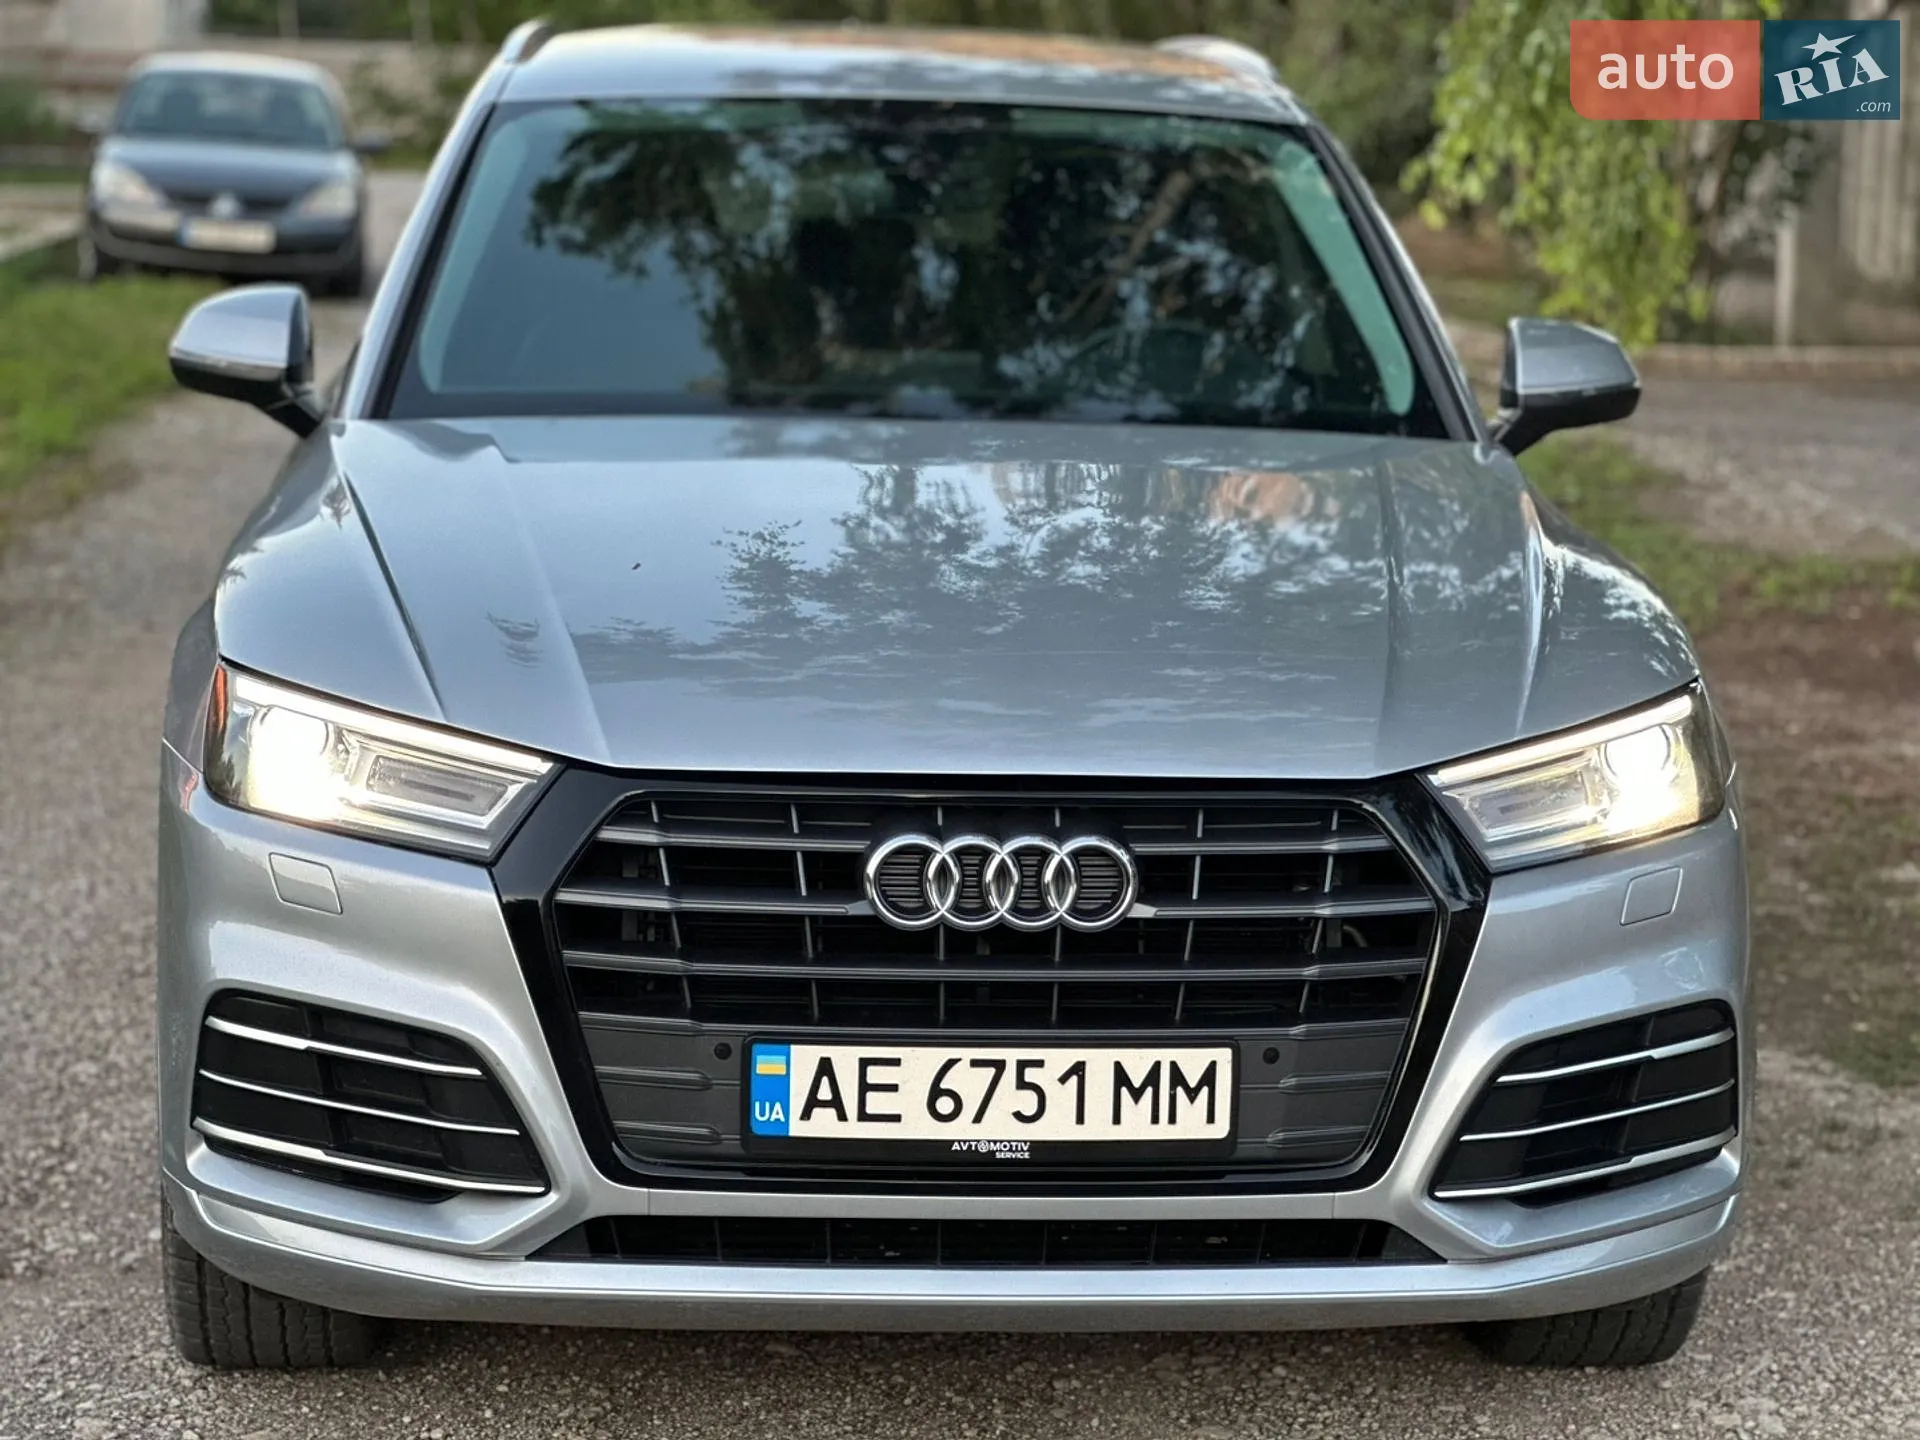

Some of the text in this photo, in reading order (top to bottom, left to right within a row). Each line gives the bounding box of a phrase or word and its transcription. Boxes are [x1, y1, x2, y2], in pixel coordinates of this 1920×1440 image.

[754, 1102, 785, 1122] UA
[799, 1056, 1217, 1125] AE 6751 MM
